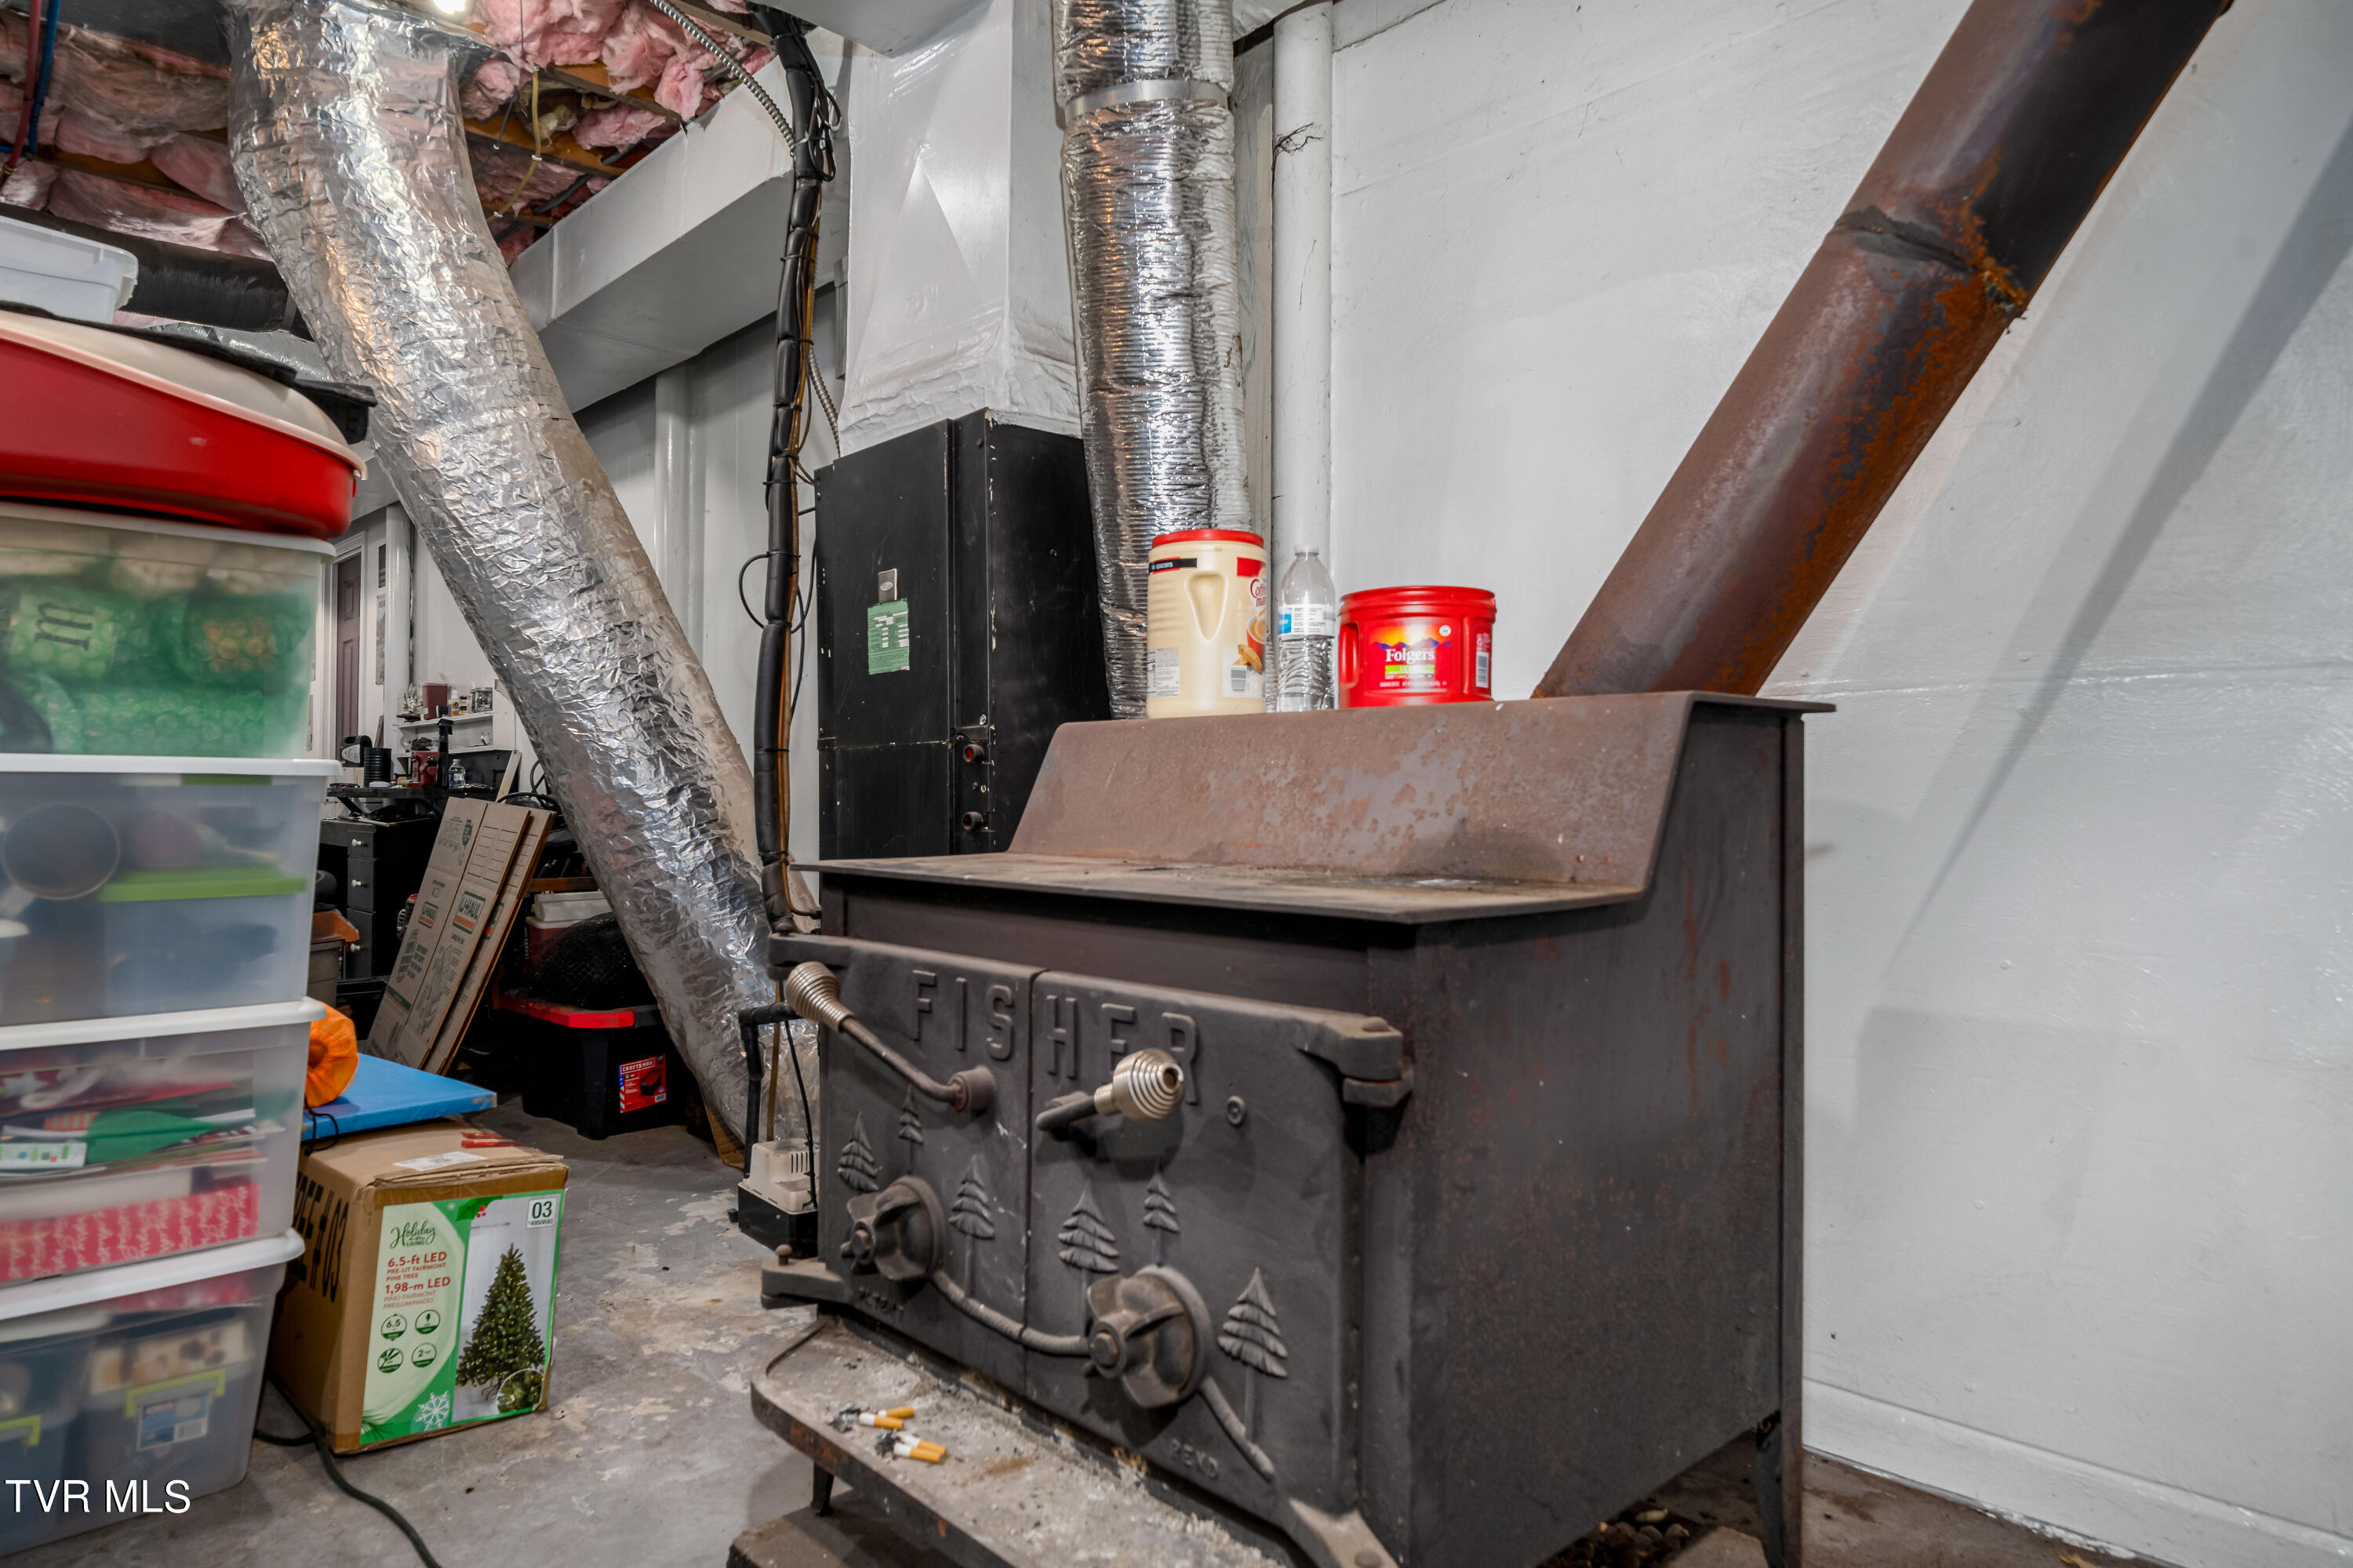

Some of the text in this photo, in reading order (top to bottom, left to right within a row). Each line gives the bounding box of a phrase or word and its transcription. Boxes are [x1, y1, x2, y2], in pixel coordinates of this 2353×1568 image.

[1249, 579, 1267, 598] Coff
[1385, 647, 1435, 665] Folgers
[911, 970, 1201, 1106] FISHER
[622, 1060, 654, 1072] CRAFTSMAN
[532, 1201, 552, 1219] 03
[390, 1220, 436, 1250] Holiday
[387, 1251, 447, 1268] 6.5-ft LED
[412, 1262, 446, 1271] FAIRMONT
[427, 1276, 451, 1289] LED
[386, 1319, 401, 1328] 6.5
